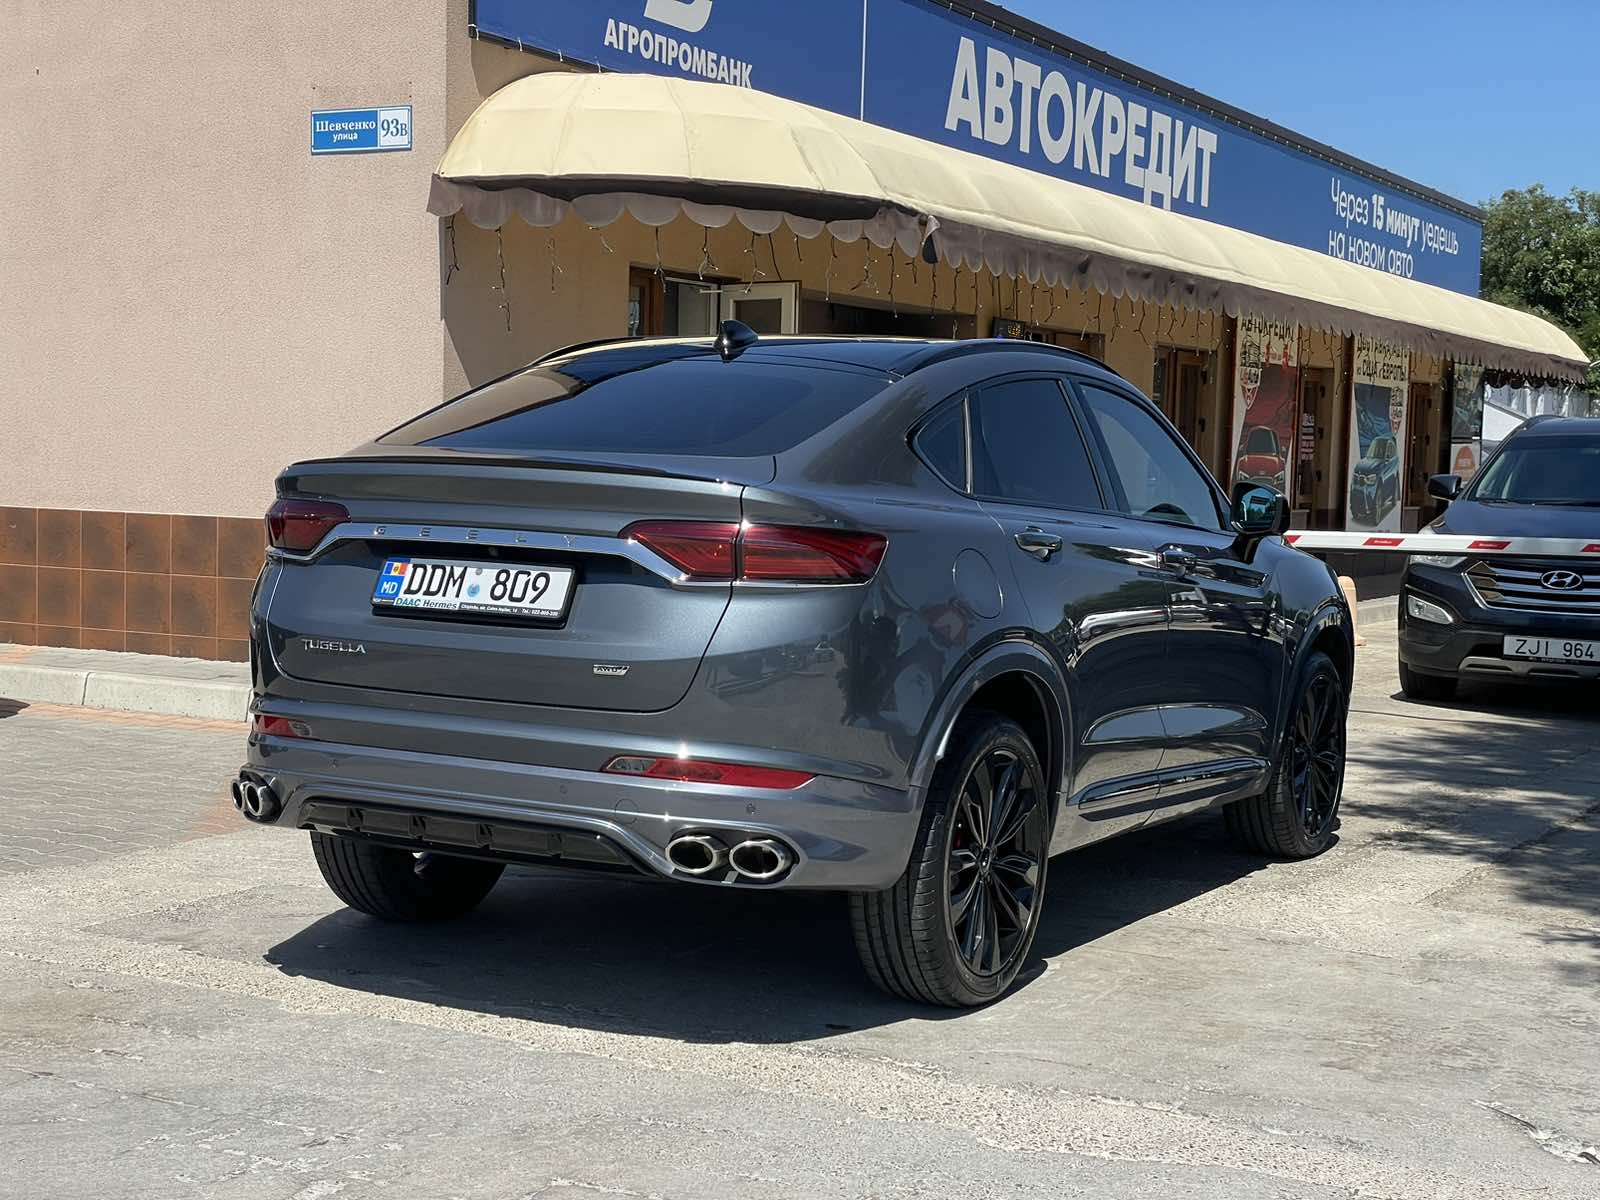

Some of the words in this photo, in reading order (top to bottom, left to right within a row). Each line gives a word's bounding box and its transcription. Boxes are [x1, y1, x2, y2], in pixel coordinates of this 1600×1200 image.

[604, 18, 753, 89] АГРОПРОМБАНК
[316, 120, 376, 132] Шевченко
[945, 36, 1218, 211] АВТОКРЕДИТ
[333, 132, 358, 143] улица
[1331, 177, 1369, 229] Через
[1372, 194, 1385, 230] 15
[1386, 208, 1420, 248] минут
[1421, 221, 1459, 255] уедешь
[1329, 230, 1346, 259] на
[1349, 236, 1386, 270] новом
[1388, 249, 1414, 278] авто
[374, 525, 577, 547] GEELY
[380, 582, 399, 595] MD
[403, 563, 468, 598] DDM
[490, 569, 551, 604] 809
[395, 597, 421, 607] DAAC
[423, 599, 457, 610] Hermes
[301, 639, 366, 654] TUGELLA
[1563, 642, 1594, 659] 964
